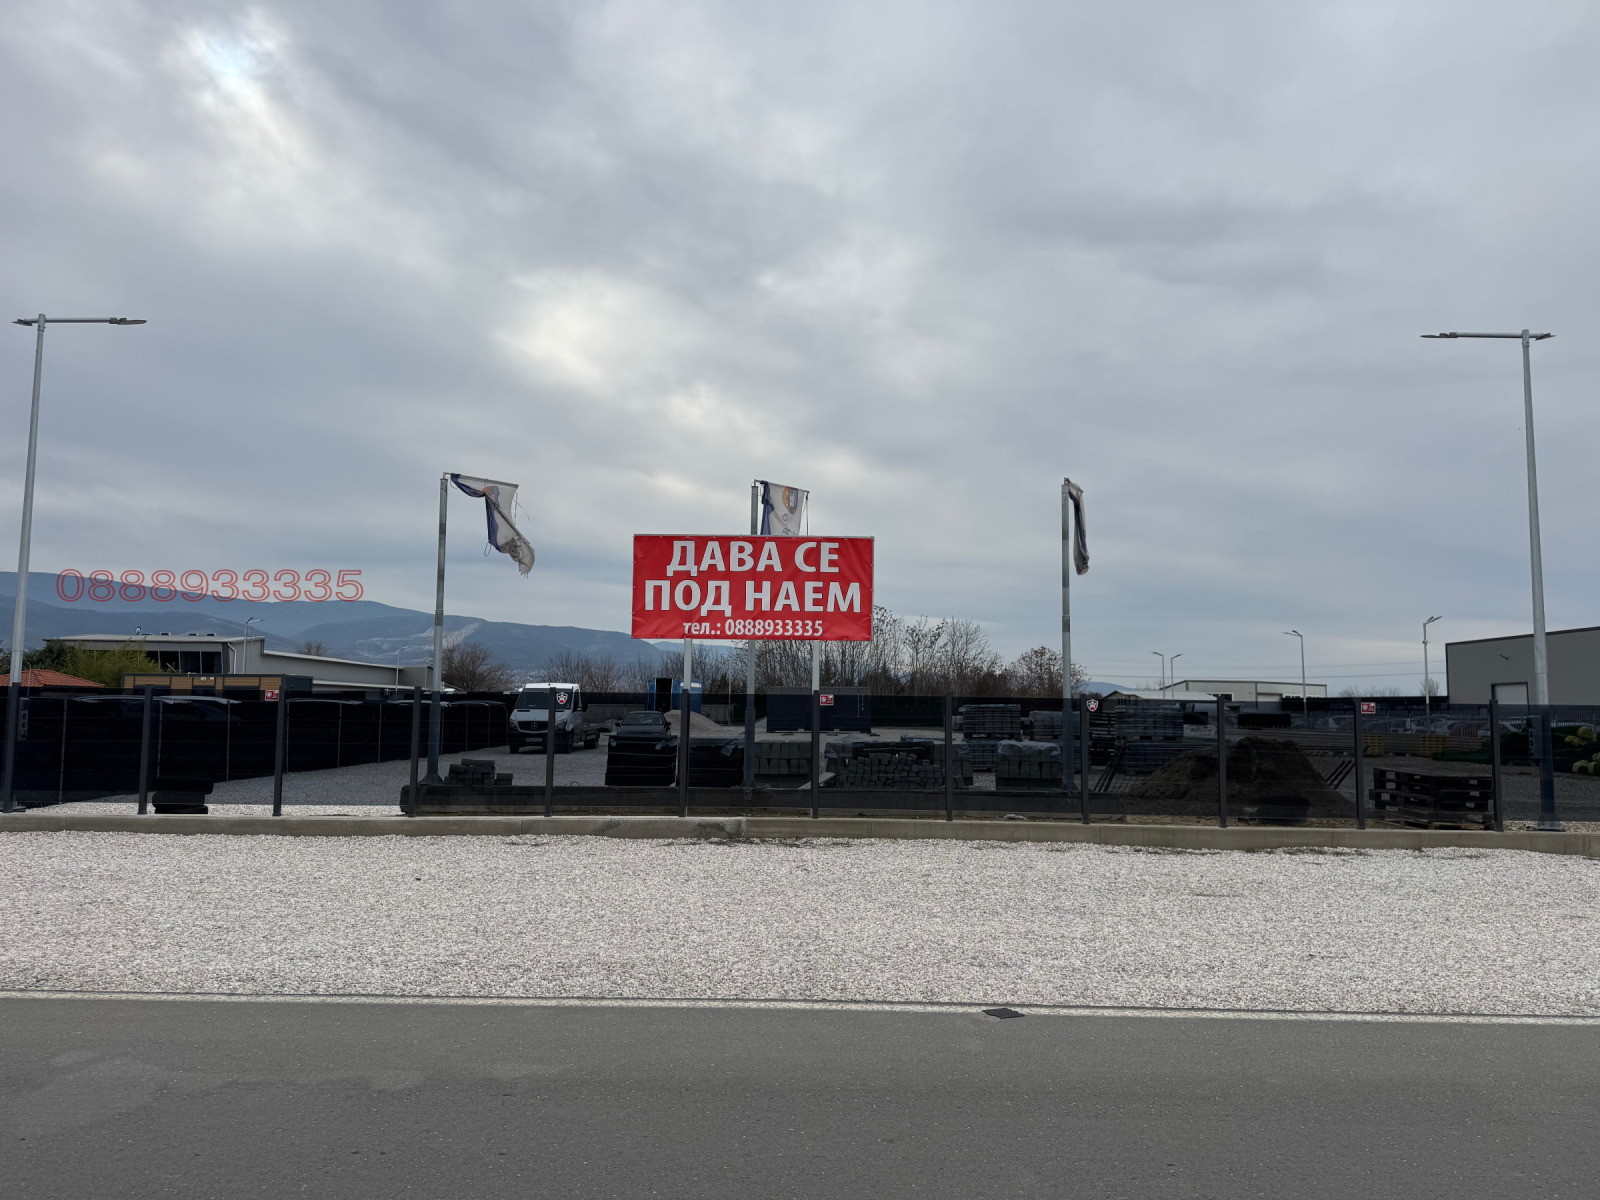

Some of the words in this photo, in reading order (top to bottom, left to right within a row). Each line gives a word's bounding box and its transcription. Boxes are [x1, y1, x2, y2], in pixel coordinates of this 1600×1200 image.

[666, 540, 782, 576] ДАВА
[794, 541, 840, 573] СЕ
[644, 579, 732, 617] ПОД
[745, 580, 861, 613] НАЕМ
[724, 619, 823, 636] 0888933335
